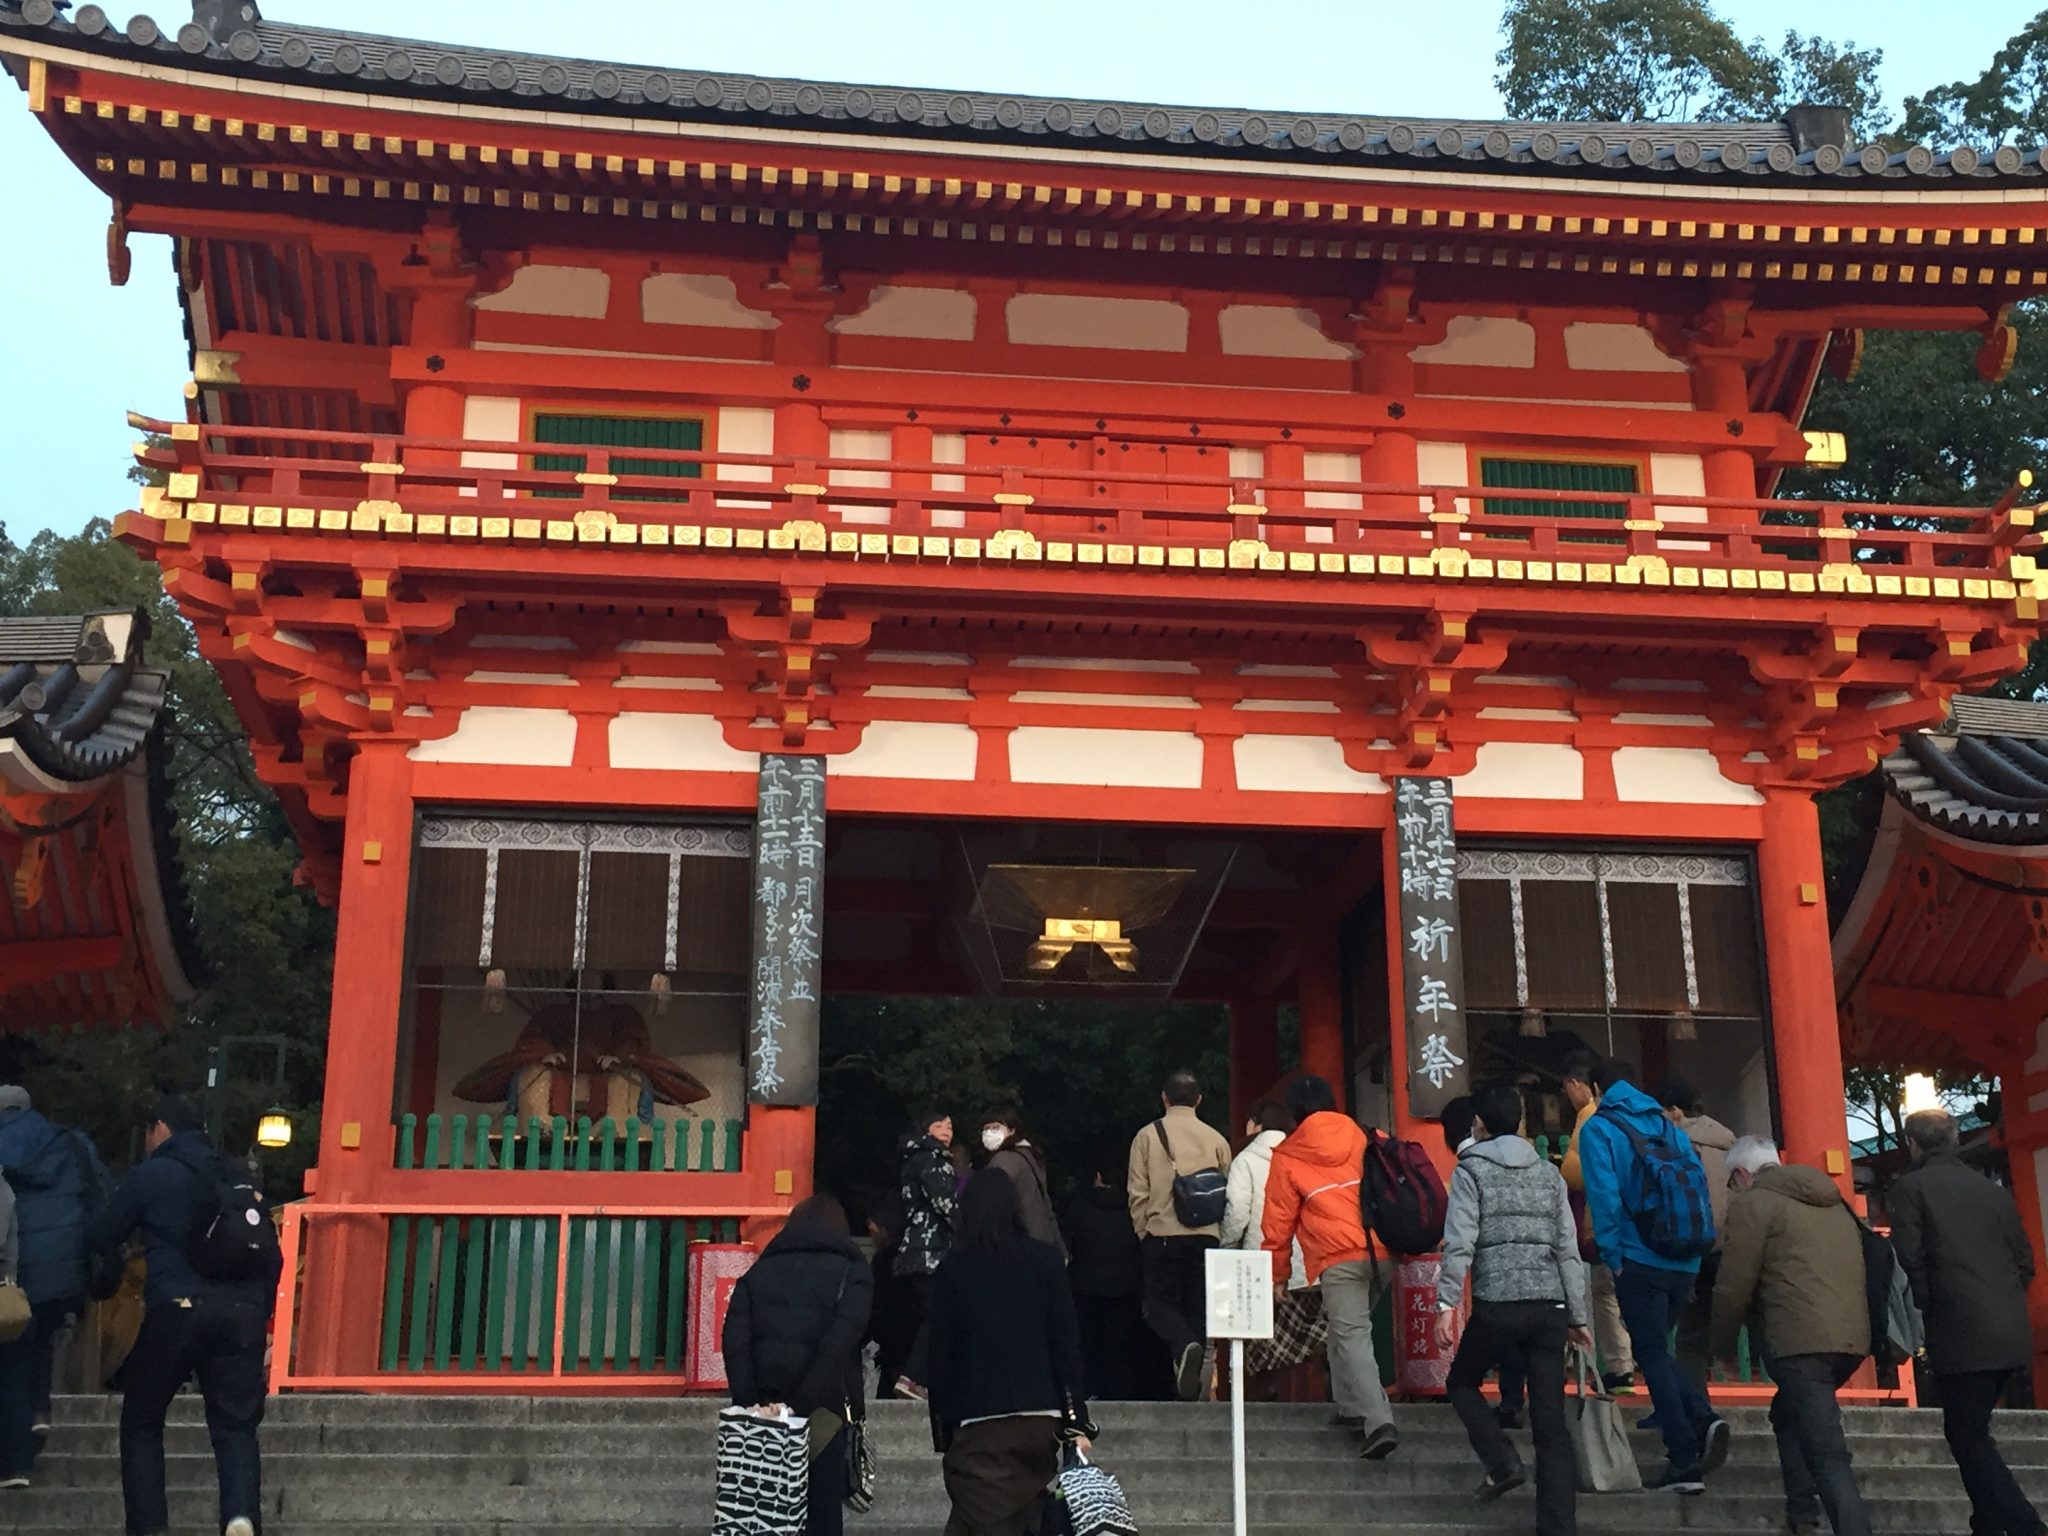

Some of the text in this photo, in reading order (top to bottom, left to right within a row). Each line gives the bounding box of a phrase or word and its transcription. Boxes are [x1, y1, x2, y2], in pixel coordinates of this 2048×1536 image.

[1398, 778, 1432, 901] 午前十時
[1423, 780, 1455, 901] 三月十七日
[1409, 916, 1464, 1089] 祈年祭
